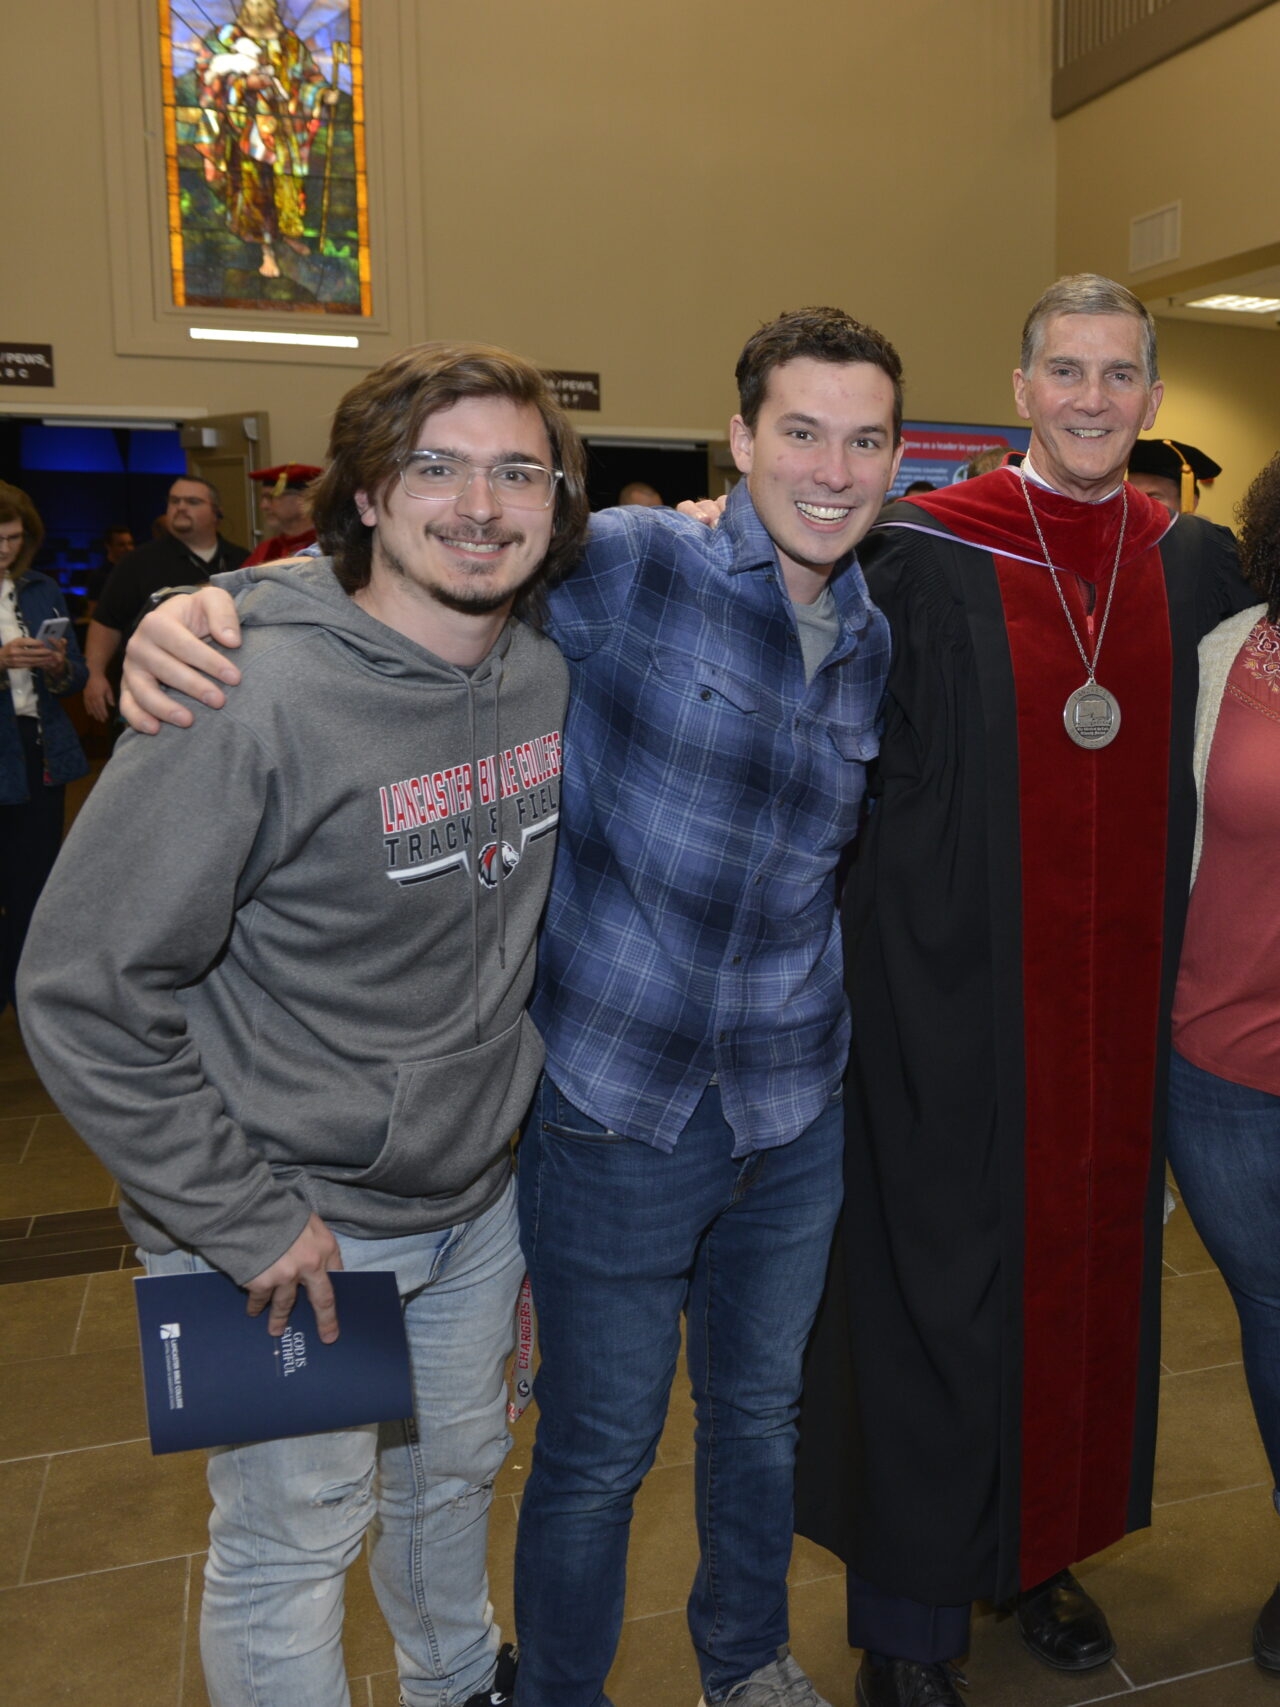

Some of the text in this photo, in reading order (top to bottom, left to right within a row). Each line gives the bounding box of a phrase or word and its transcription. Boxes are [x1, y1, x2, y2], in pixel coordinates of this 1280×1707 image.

[379, 763, 472, 834] LANCASTER
[515, 731, 564, 790] COLLEGE
[384, 815, 473, 867] TRACK
[515, 779, 563, 825] FIEL
[281, 1326, 297, 1377] FAITHFUL
[293, 1331, 307, 1368] GOD IS
[518, 1302, 532, 1370] CHARGERS
